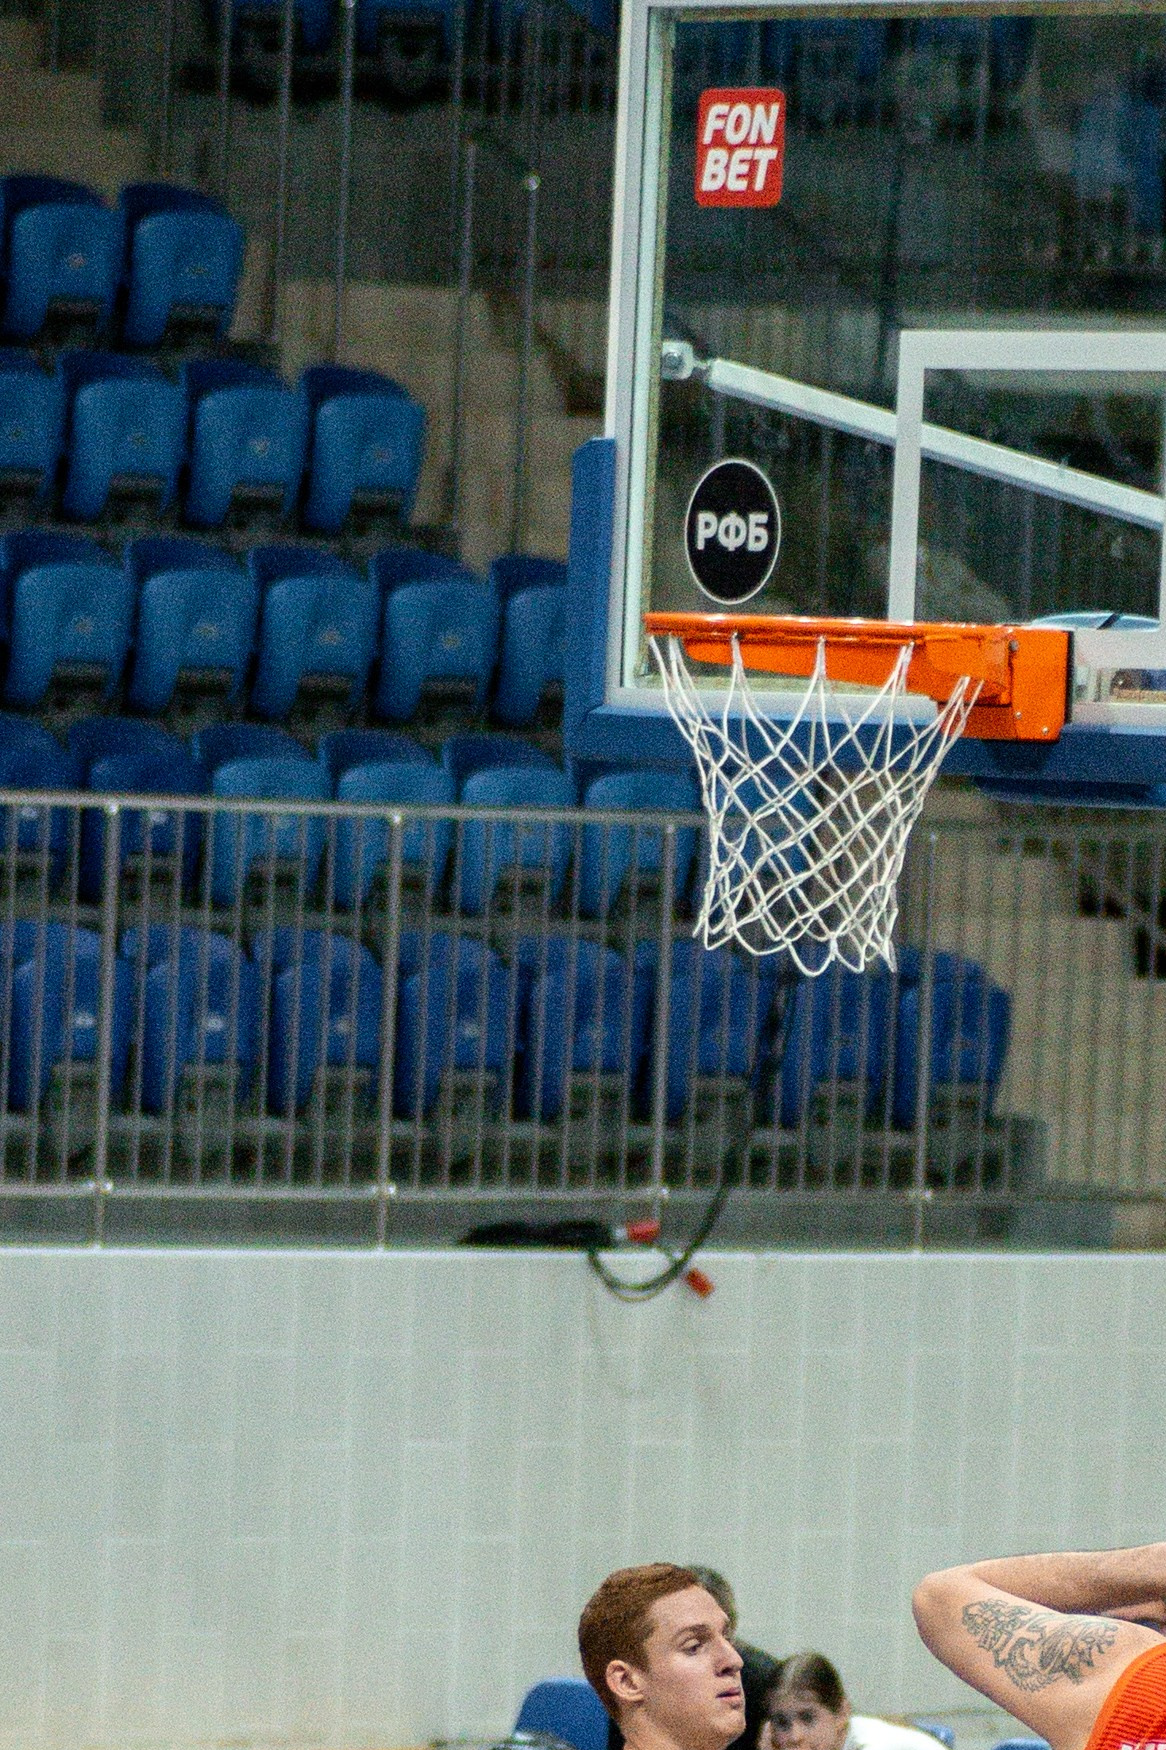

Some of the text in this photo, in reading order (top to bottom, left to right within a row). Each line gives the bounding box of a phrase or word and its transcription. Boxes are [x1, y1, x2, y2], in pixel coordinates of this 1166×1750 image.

[702, 103, 780, 145] FON
[701, 147, 778, 192] BET
[697, 511, 769, 551] РФБ
